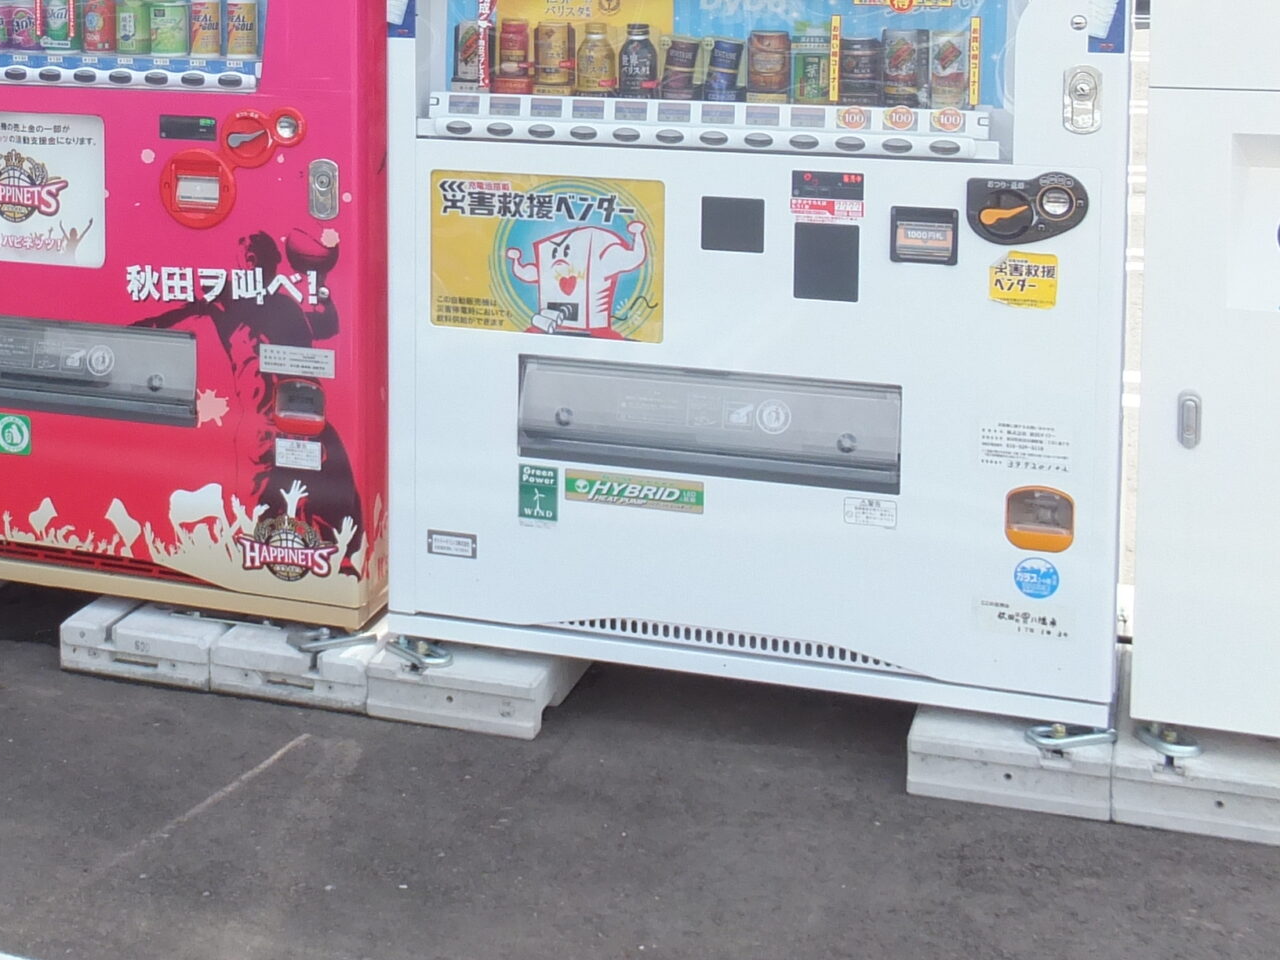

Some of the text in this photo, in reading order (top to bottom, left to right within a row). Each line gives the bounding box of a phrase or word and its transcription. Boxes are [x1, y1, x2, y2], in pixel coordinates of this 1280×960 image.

[844, 112, 864, 124] 100
[891, 112, 912, 123] 100
[939, 113, 960, 125] 100
[438, 179, 636, 224] 災害救援ベンダー
[125, 264, 319, 305] 秋田ヲ叫べ!
[994, 278, 1037, 292] ベンダー
[523, 466, 554, 478] Green
[522, 474, 555, 486] Power
[587, 479, 681, 501] HYBRID
[524, 507, 553, 519] WIND
[240, 538, 338, 577] HAPPINETS
